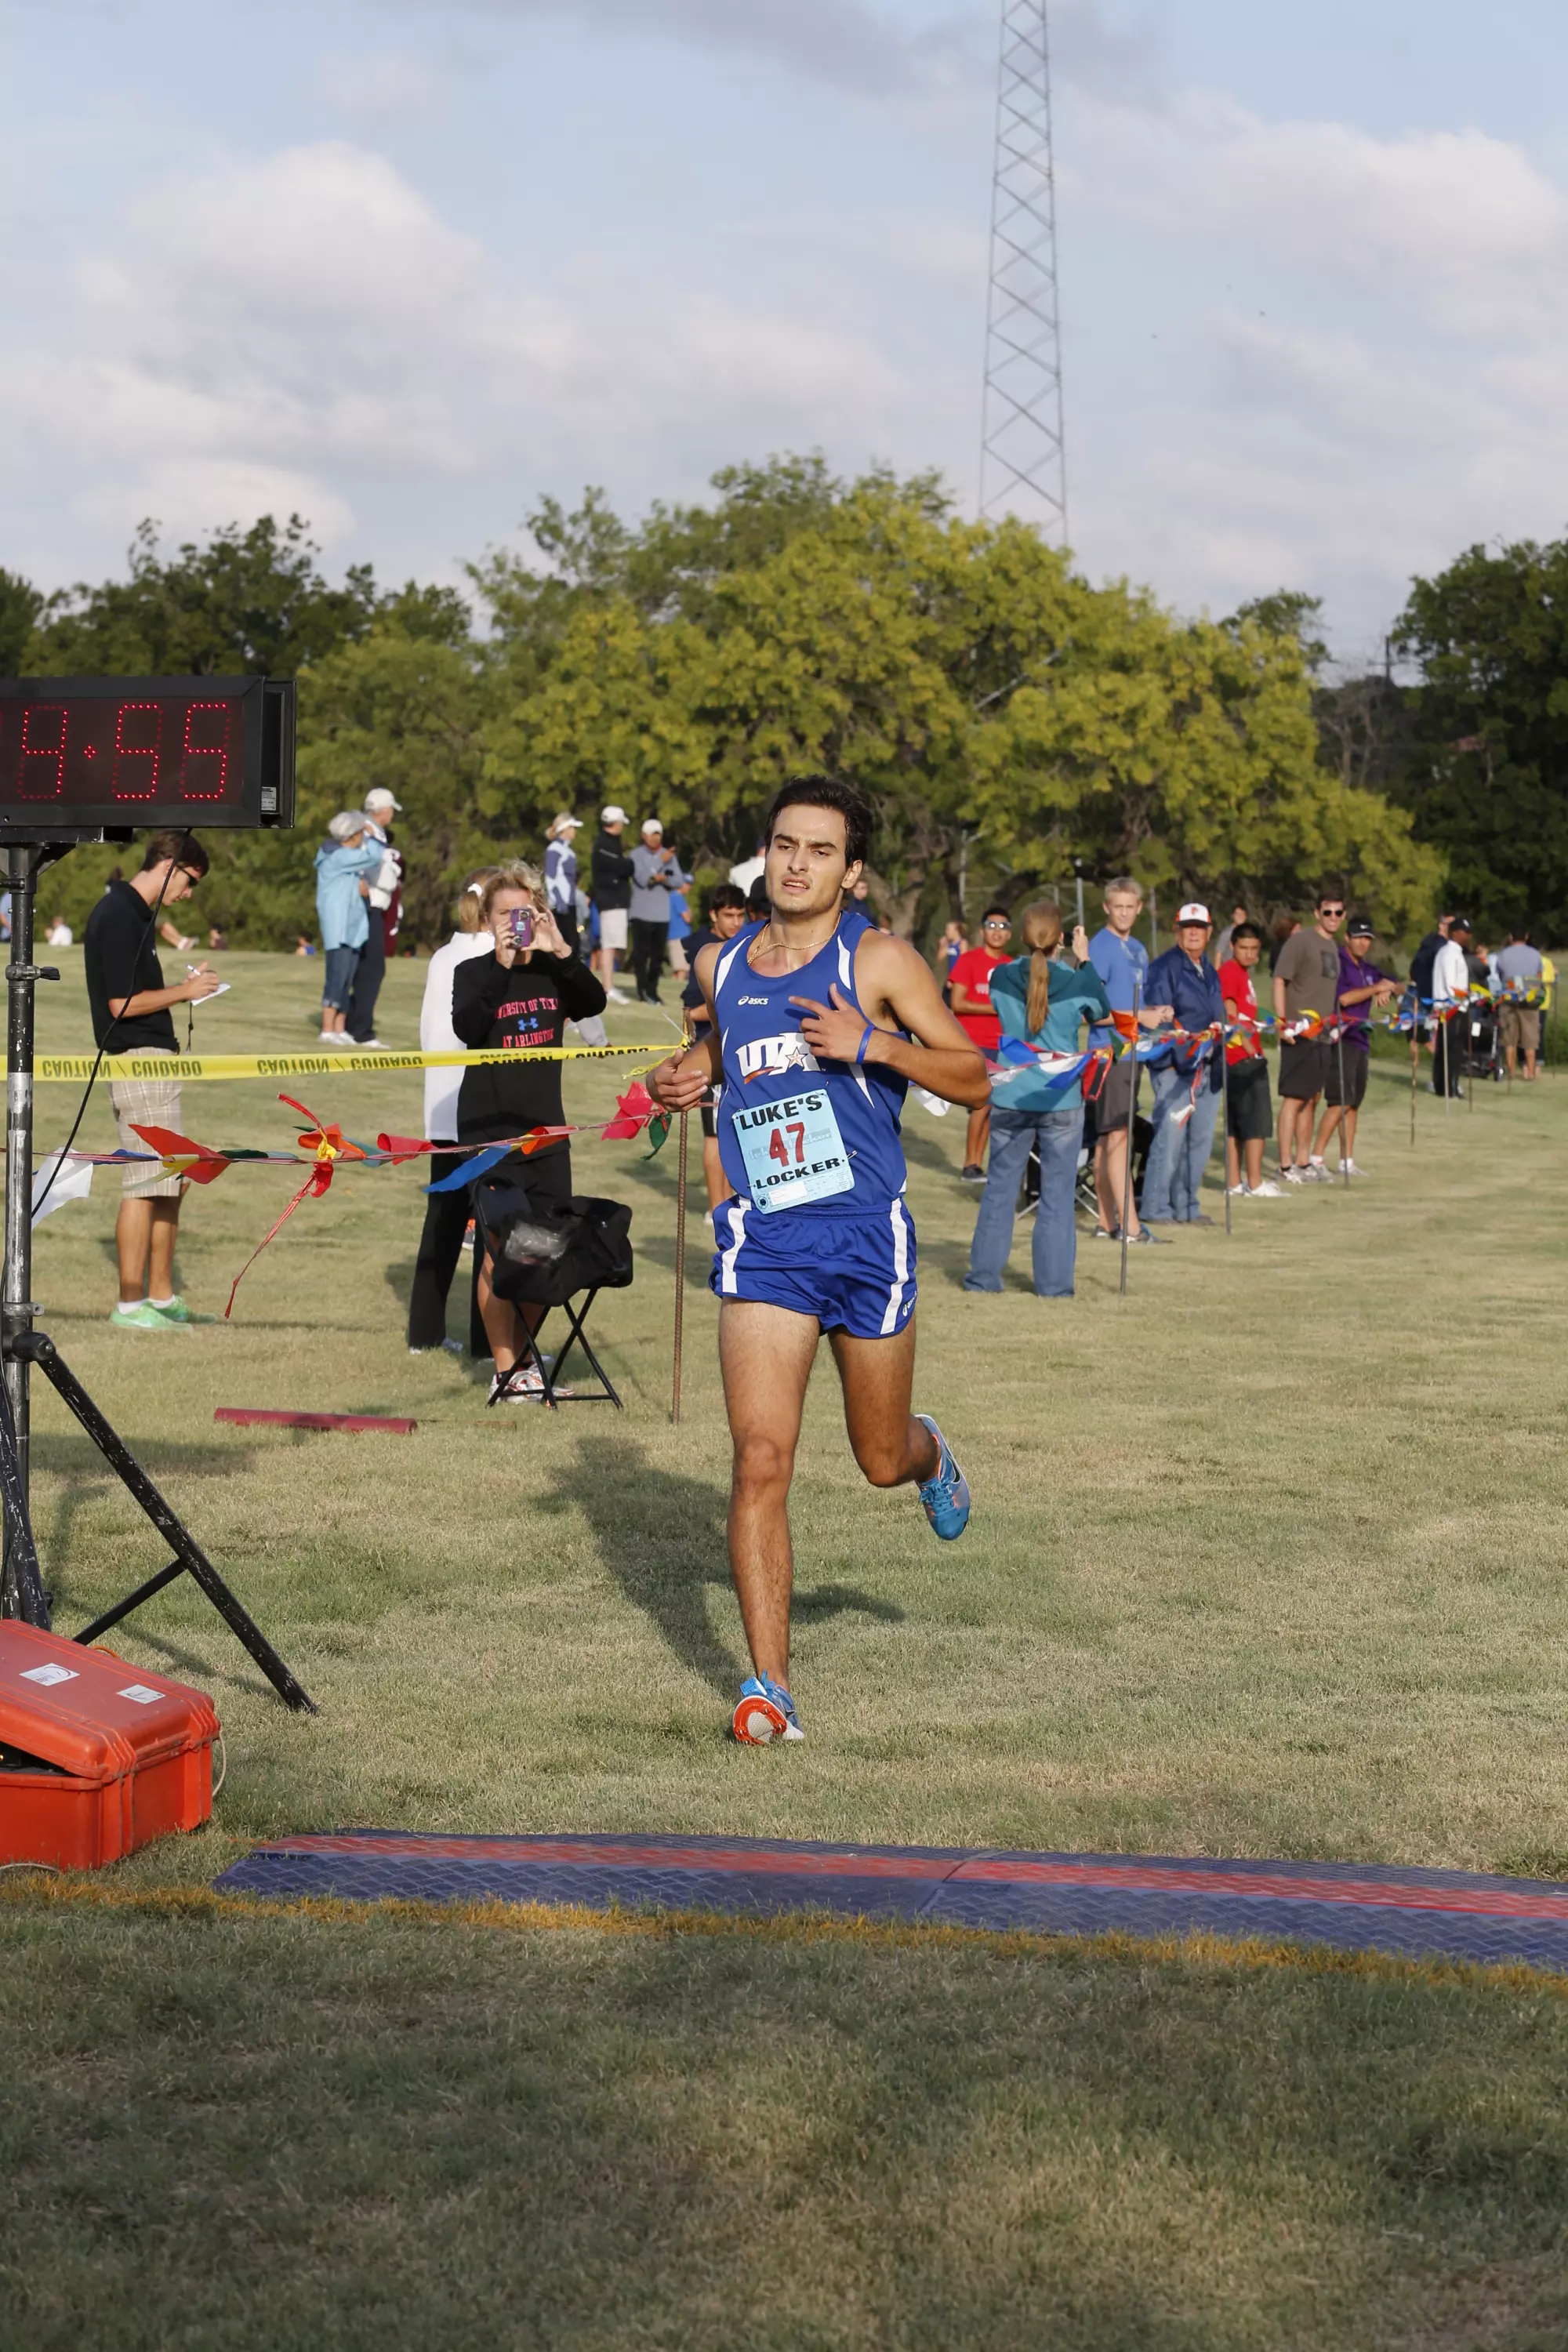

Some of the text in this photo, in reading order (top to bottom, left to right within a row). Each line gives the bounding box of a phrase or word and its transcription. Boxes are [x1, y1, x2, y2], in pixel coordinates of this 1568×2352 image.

[528, 998, 539, 1012] OF
[503, 1035, 513, 1048] AT
[739, 1094, 822, 1131] LUKE'S
[769, 1122, 805, 1167] 47
[755, 1158, 840, 1189] LOCKER
